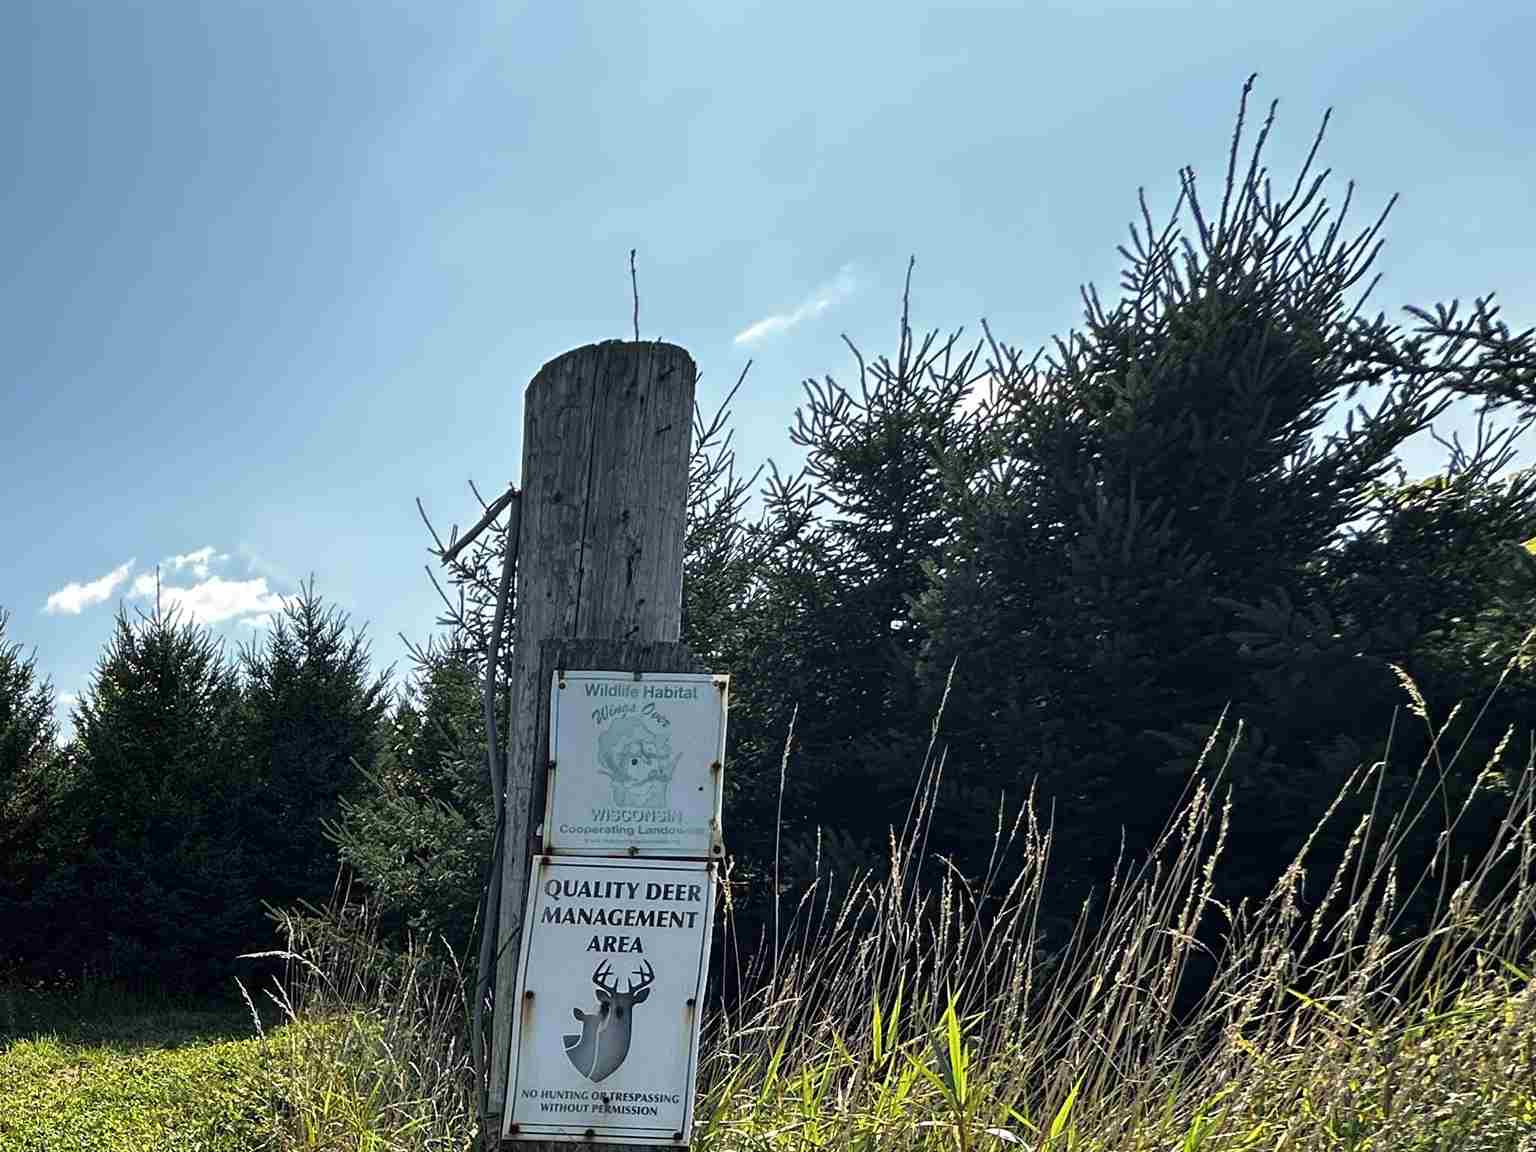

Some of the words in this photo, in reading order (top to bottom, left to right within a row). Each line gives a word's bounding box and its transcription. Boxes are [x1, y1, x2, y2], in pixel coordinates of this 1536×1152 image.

[585, 683, 640, 699] Wildlife
[592, 808, 683, 823] WISCONSIN
[560, 824, 635, 836] Cooperating
[544, 879, 641, 902] QUALITY
[646, 883, 702, 902] DEER
[541, 907, 700, 929] MANAGEMENT
[586, 935, 643, 953] AREA
[520, 1089, 539, 1099] NO
[540, 1090, 589, 1101] HUNTING
[591, 1091, 607, 1102] OR
[608, 1092, 680, 1105] TRESPASSING
[540, 1103, 589, 1114] WITHOUT
[591, 1103, 659, 1116] PERMISSION
